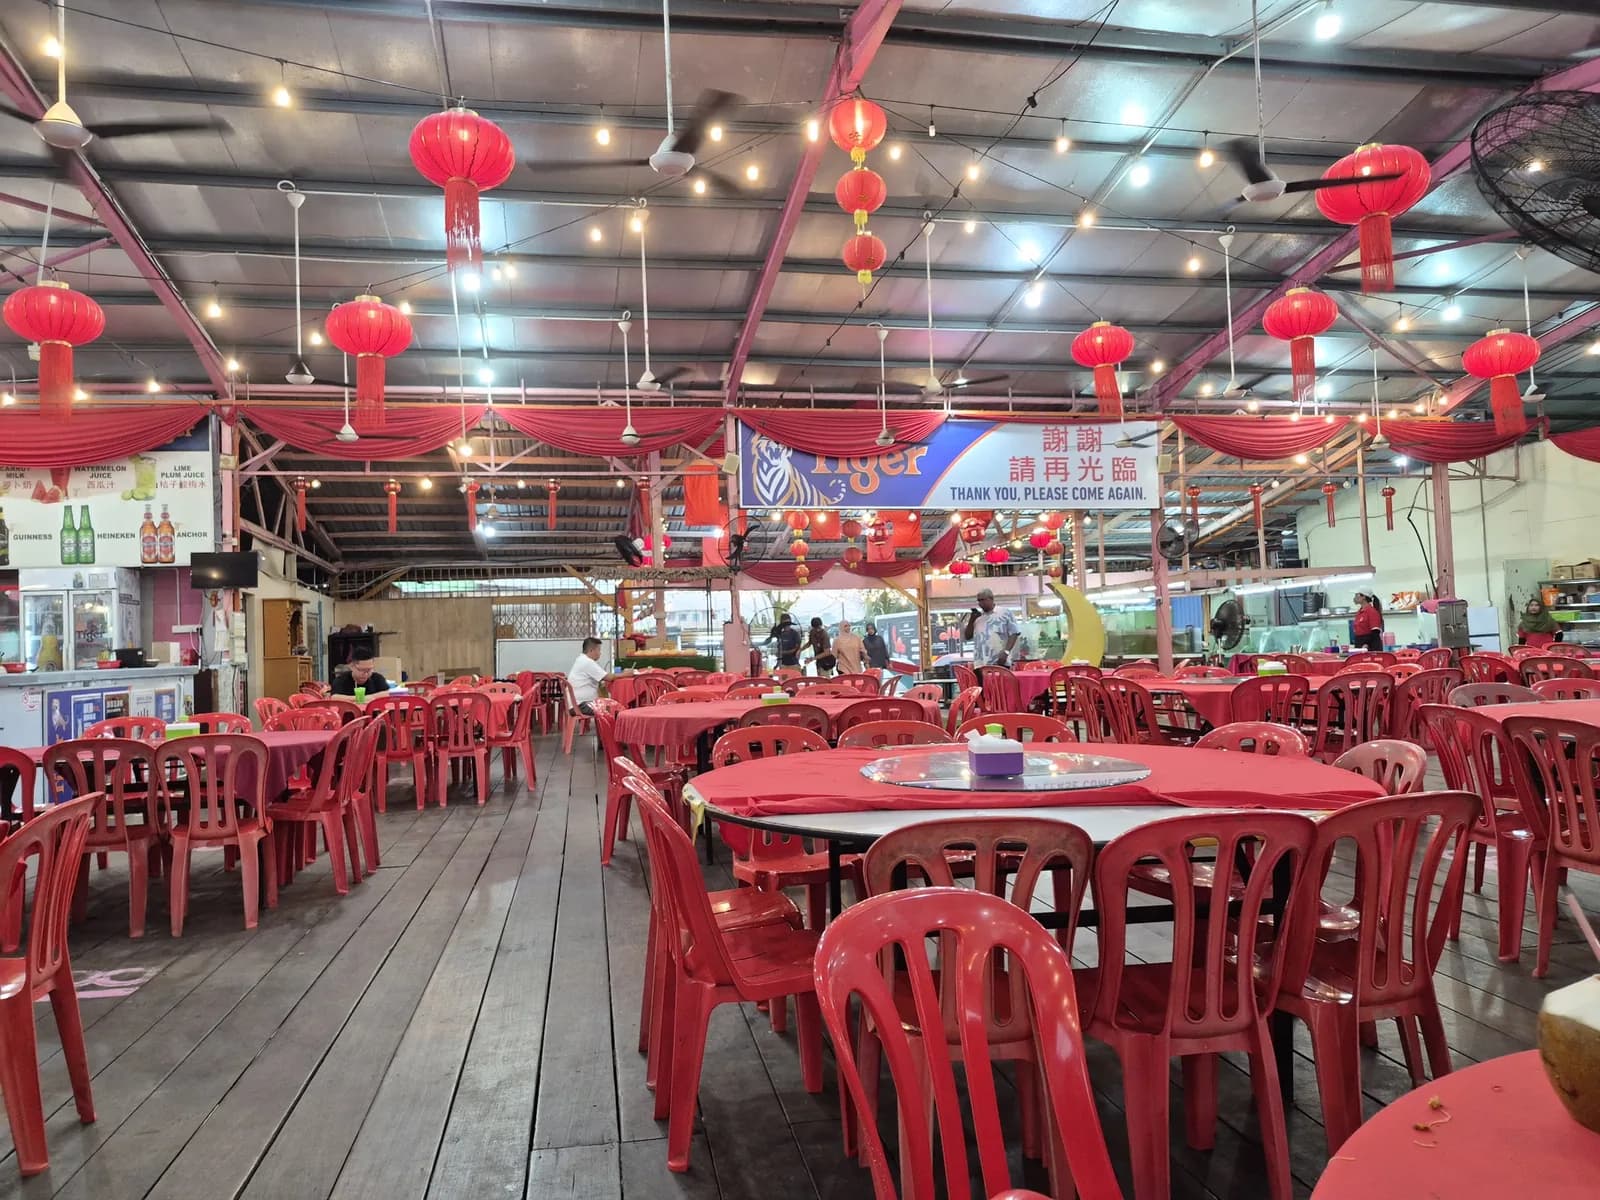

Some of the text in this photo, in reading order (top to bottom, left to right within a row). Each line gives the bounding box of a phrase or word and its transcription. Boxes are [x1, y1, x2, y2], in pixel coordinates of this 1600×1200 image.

[1042, 426, 1103, 453] 謝謝
[1009, 456, 1137, 482] 請再光臨
[950, 486, 1147, 502] THANK YOU, PLEASE COME AGAIN.
[13, 533, 53, 541] GUINNESS
[97, 532, 136, 540] HEINEKEN
